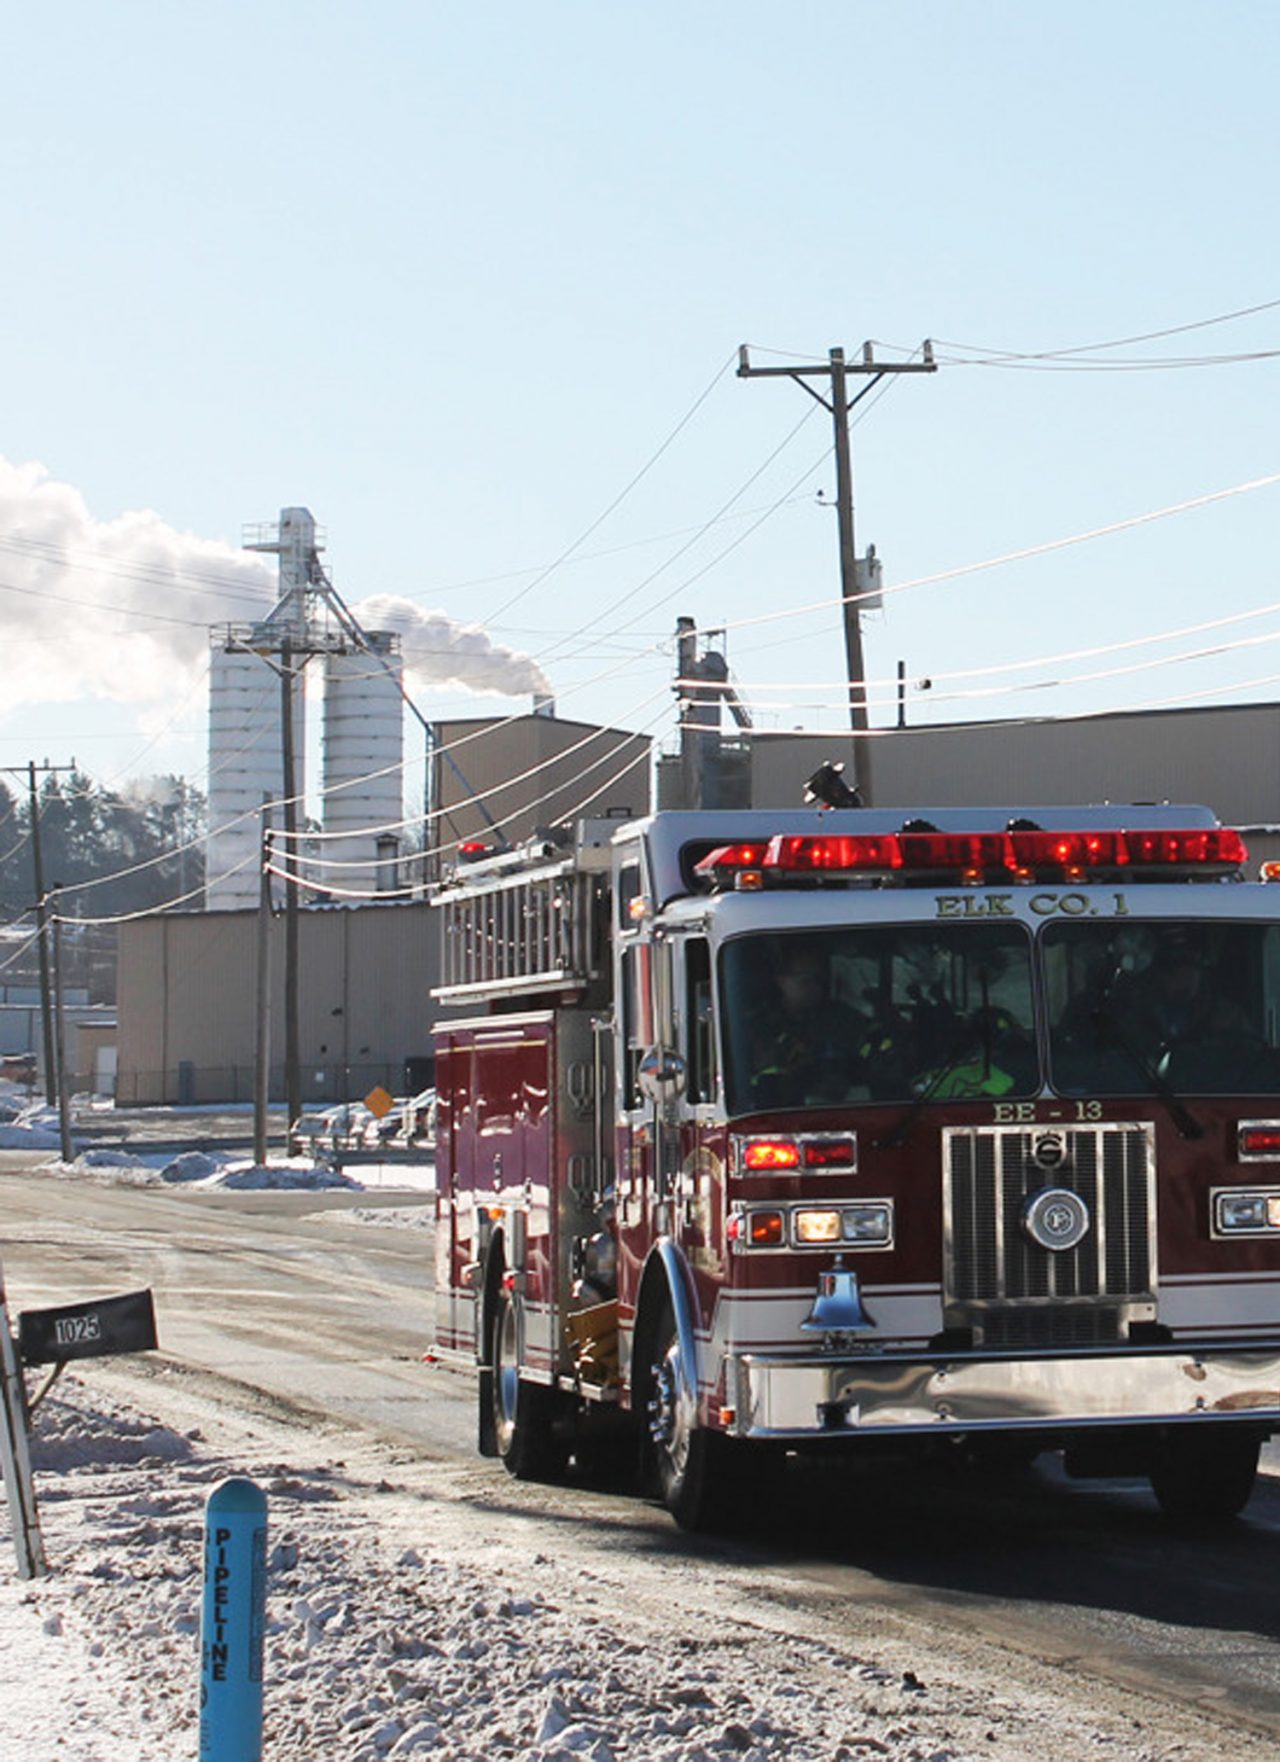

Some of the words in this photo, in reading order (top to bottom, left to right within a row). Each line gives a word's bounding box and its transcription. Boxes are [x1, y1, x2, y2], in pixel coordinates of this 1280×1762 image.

[935, 894, 1014, 917] ELK
[1028, 893, 1099, 916] CO.
[1113, 893, 1129, 916] 1
[993, 1102, 1036, 1123] EE
[1075, 1101, 1103, 1121] 13
[56, 1314, 100, 1344] 1025
[211, 1527, 232, 1682] PIPELINE
